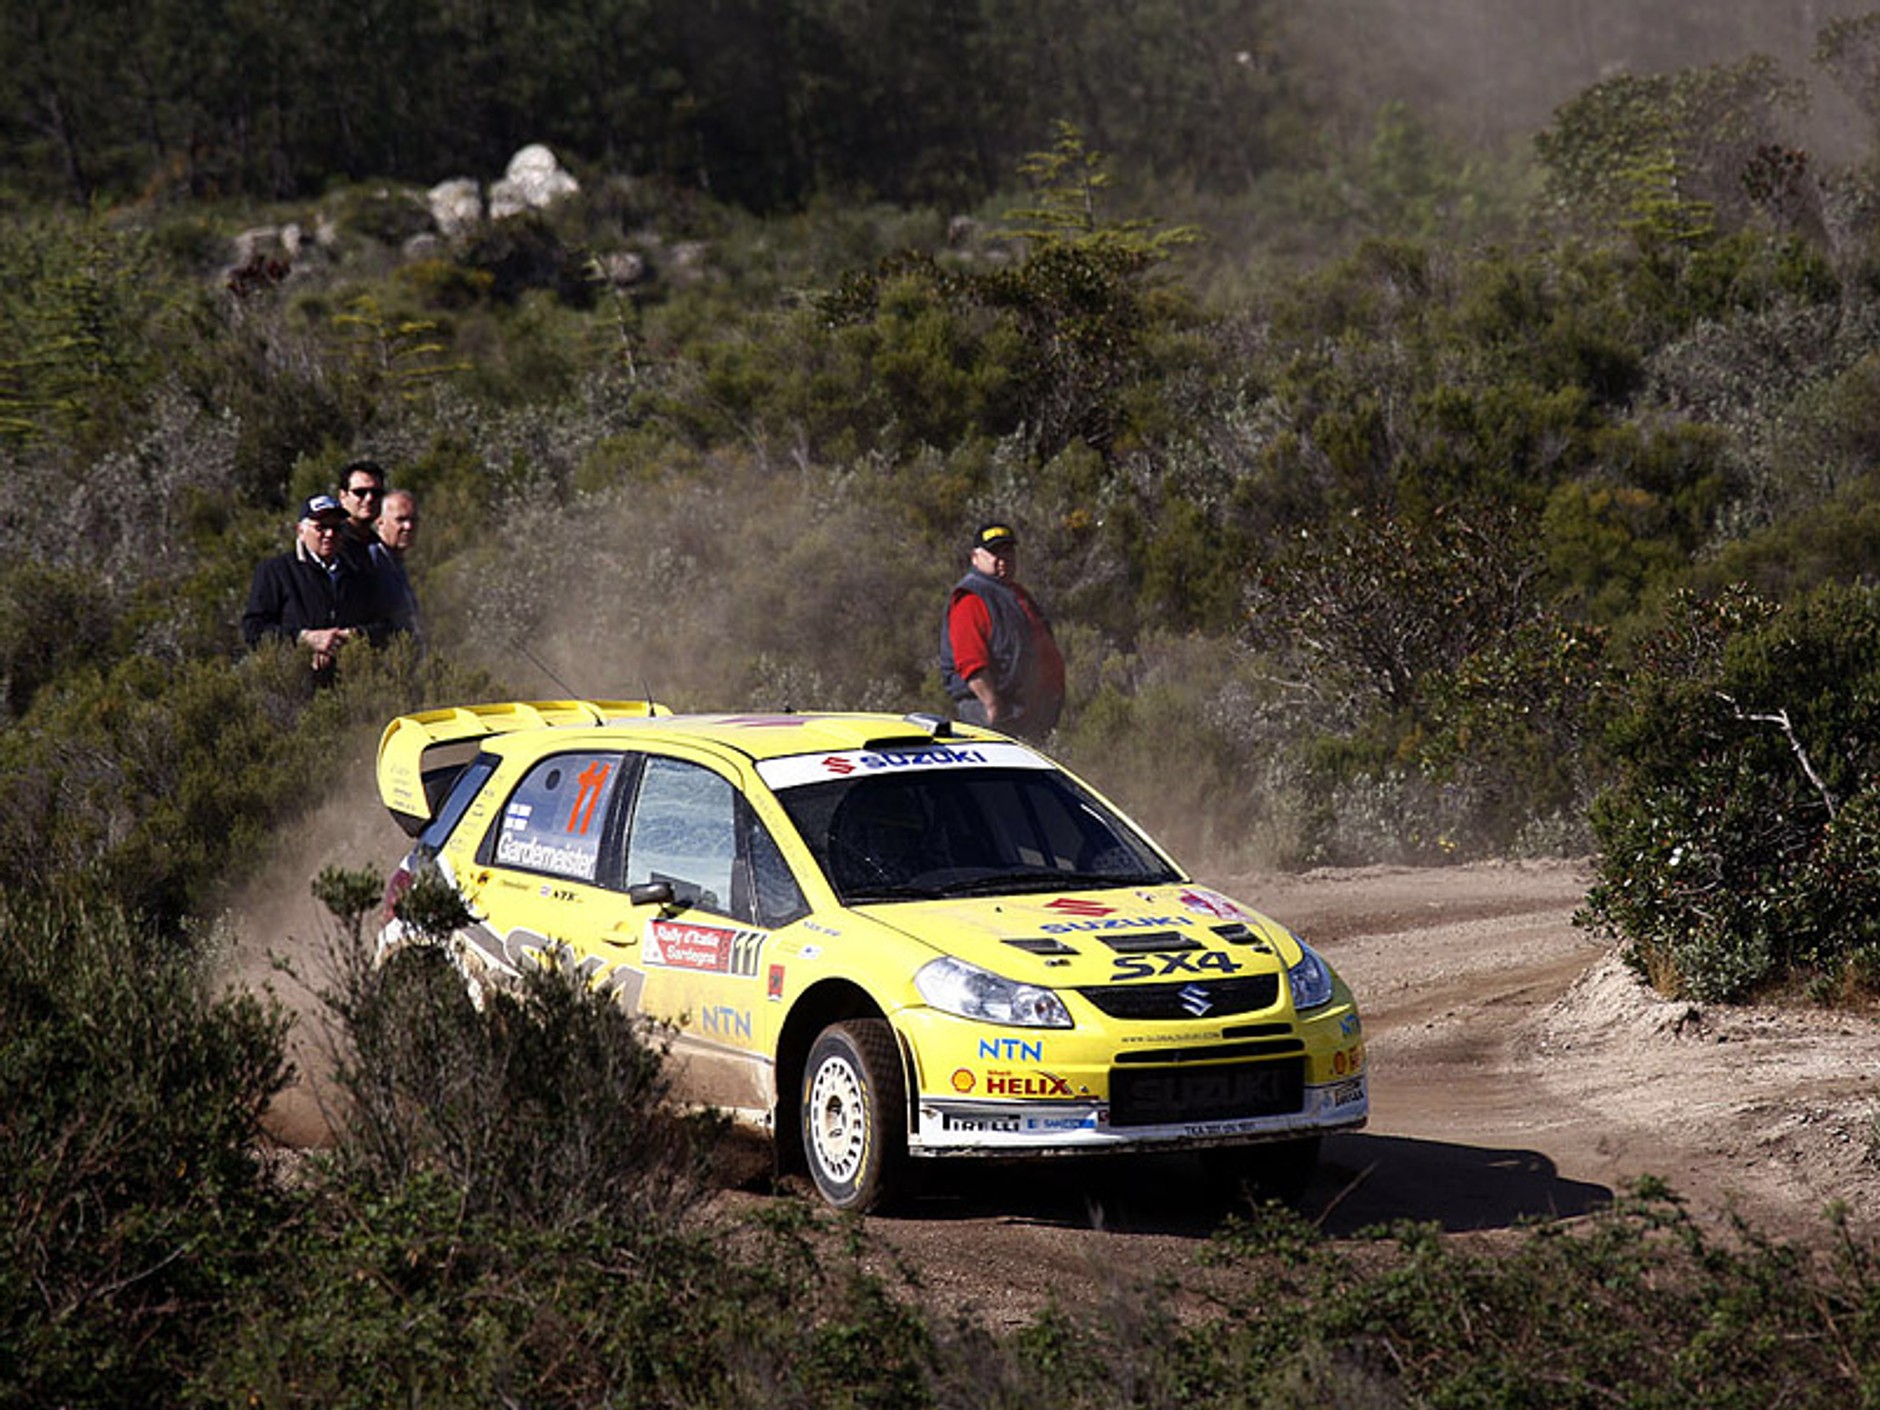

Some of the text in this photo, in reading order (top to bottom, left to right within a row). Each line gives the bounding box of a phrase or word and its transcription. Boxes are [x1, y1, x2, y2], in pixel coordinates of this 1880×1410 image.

[860, 750, 988, 770] SUZUKI
[566, 760, 612, 836] 11
[497, 831, 597, 881] Gardemeister
[1039, 916, 1194, 933] SUZUKI
[1110, 952, 1243, 981] SX4
[702, 1005, 752, 1039] NTN
[979, 1038, 1042, 1061] NTN
[986, 1077, 1069, 1095] HELIX
[943, 1113, 1021, 1132] PIRELLI
